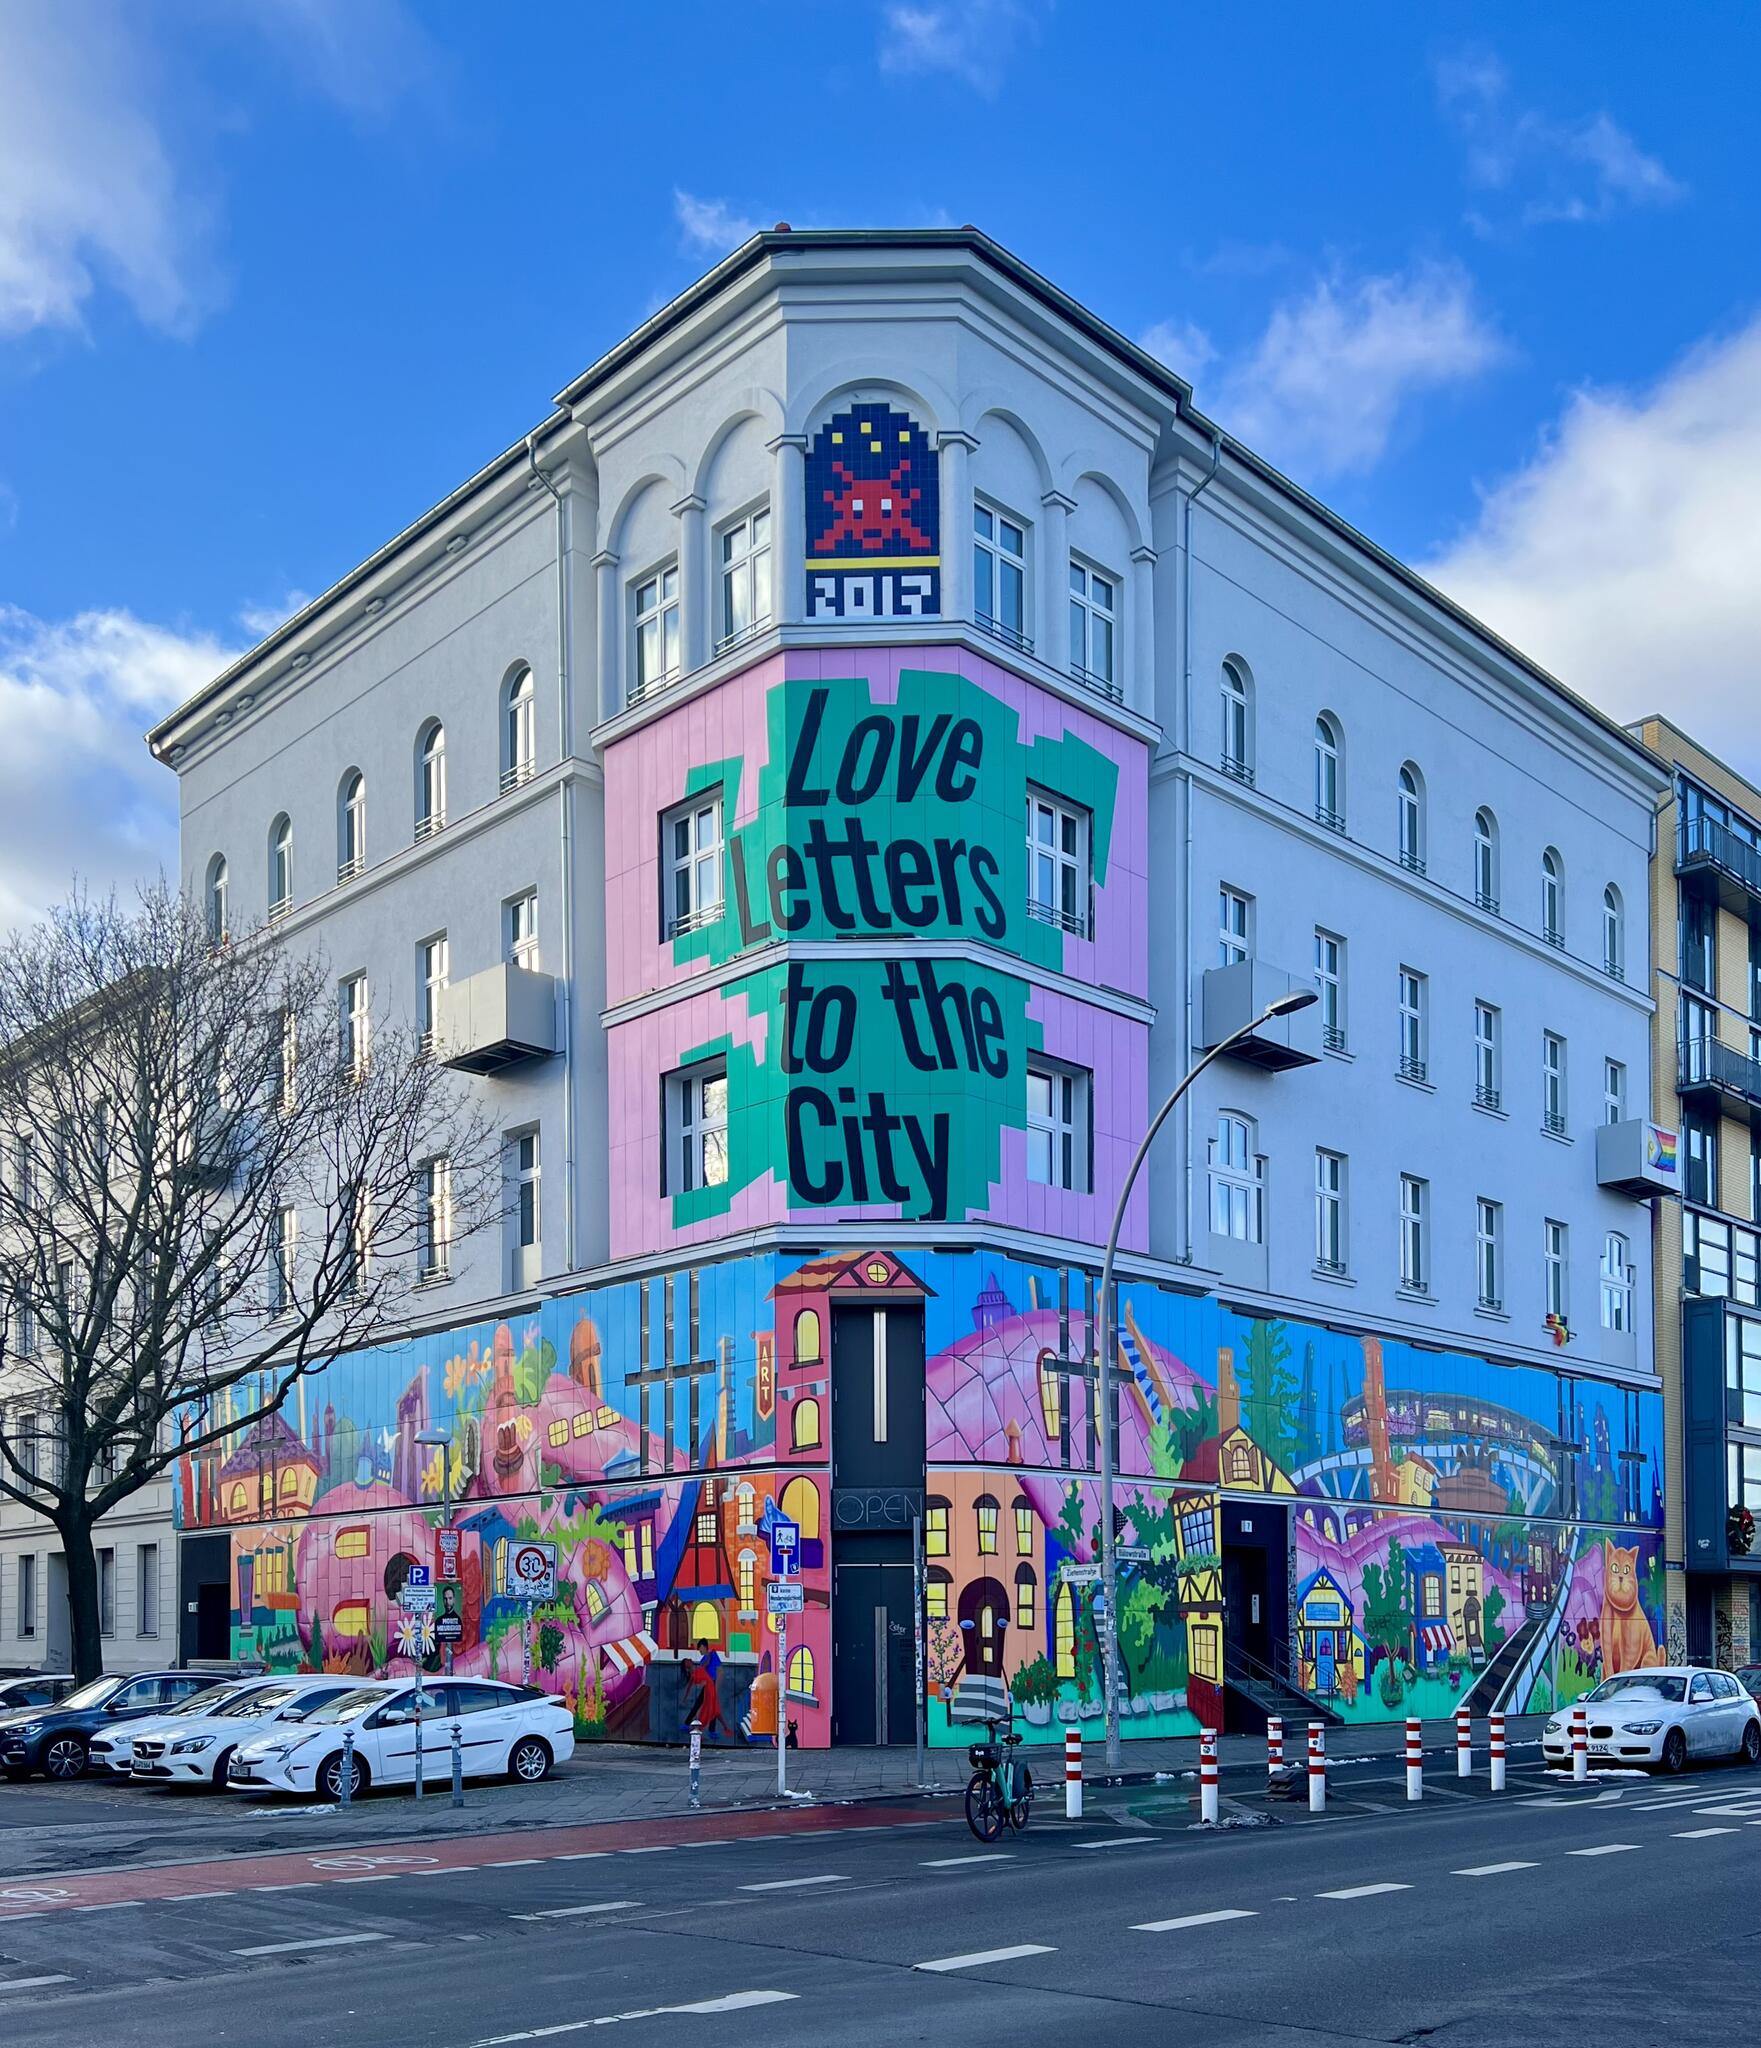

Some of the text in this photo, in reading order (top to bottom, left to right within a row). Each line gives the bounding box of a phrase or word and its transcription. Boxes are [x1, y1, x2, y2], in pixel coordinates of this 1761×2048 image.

[814, 575, 932, 617] 2017
[783, 688, 983, 807] Love
[729, 818, 1007, 948] Letters
[779, 960, 1009, 1079] to the
[784, 1086, 950, 1221] City
[761, 1345, 771, 1401] ART
[836, 1494, 923, 1523] OPEN
[412, 1568, 424, 1583] P
[522, 1556, 541, 1573] 30
